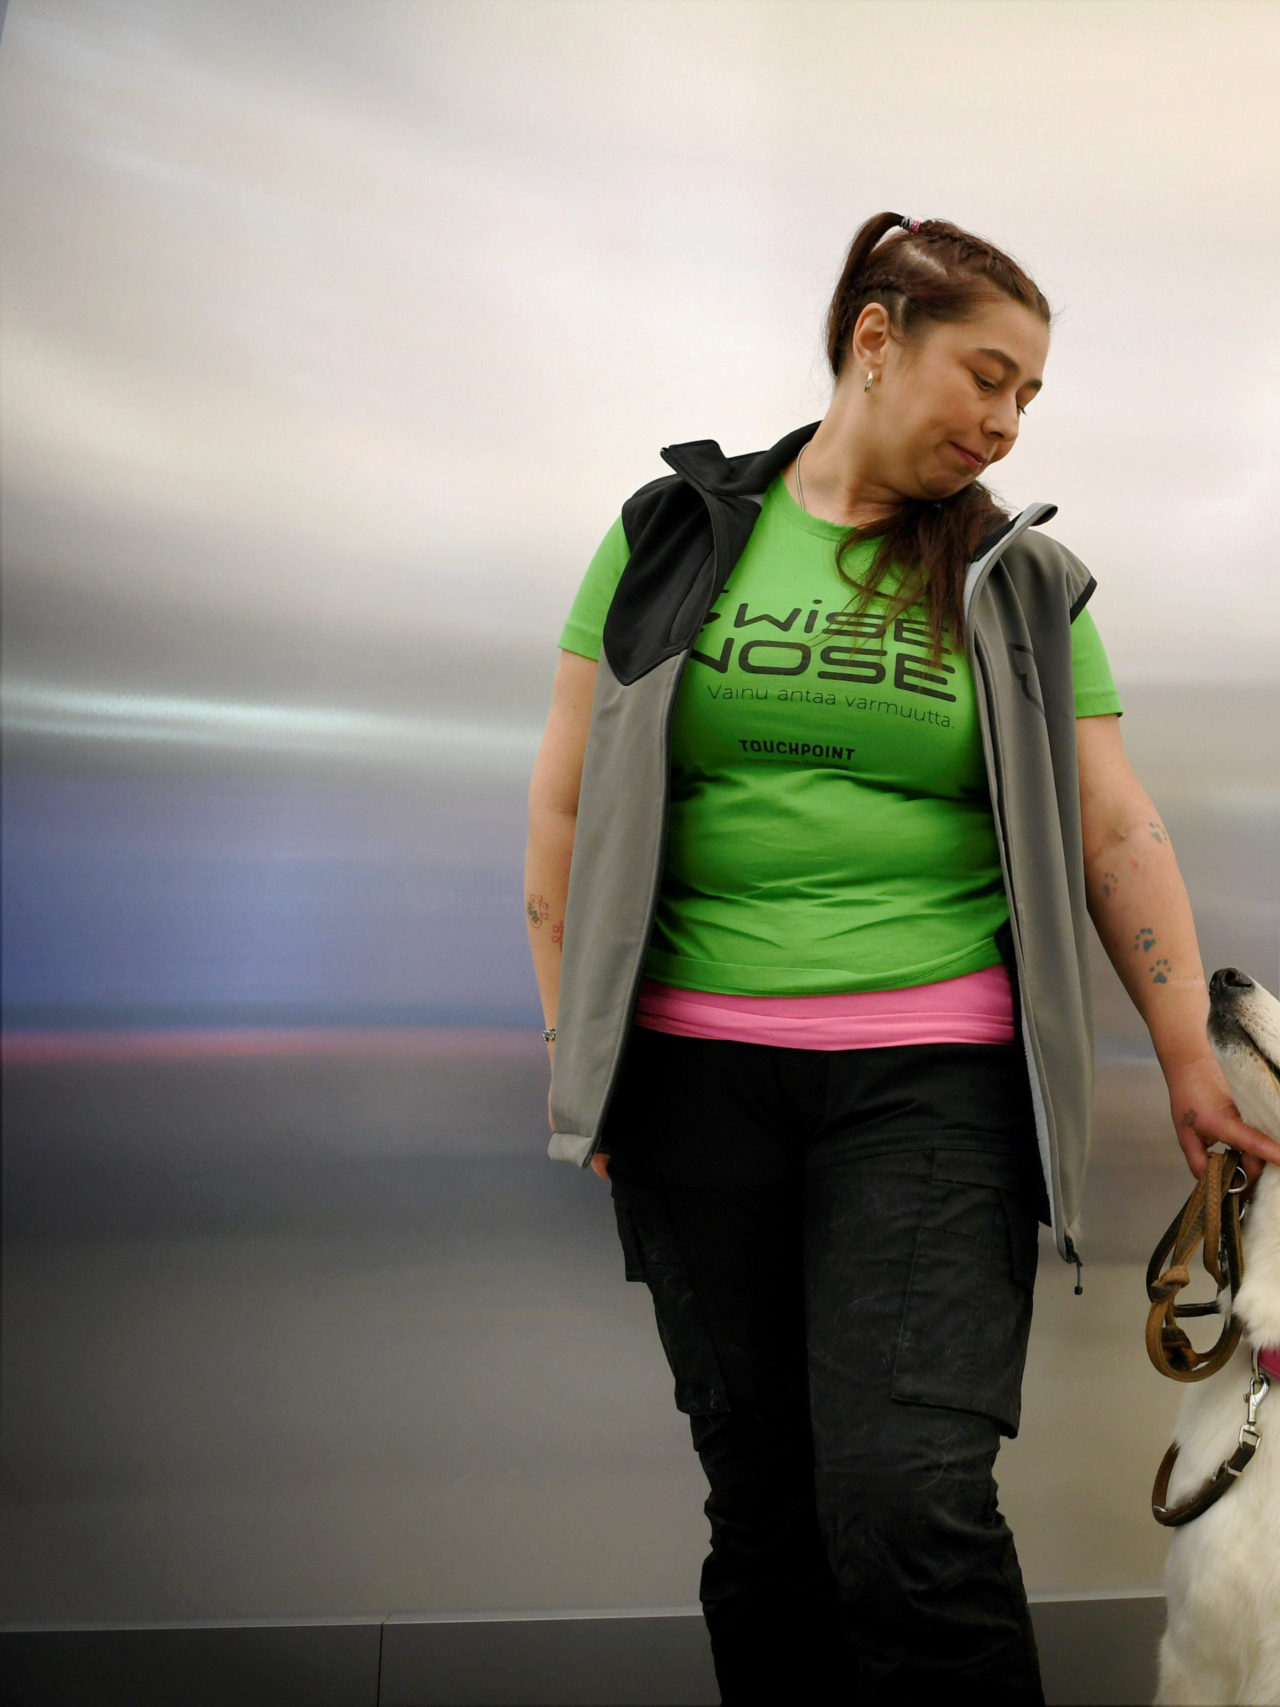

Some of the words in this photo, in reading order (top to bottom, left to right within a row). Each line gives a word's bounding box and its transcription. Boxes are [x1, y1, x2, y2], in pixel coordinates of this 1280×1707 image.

[707, 684, 768, 700] Vainu
[777, 689, 836, 705] antaa
[738, 739, 856, 761] TOUCHPOINT
